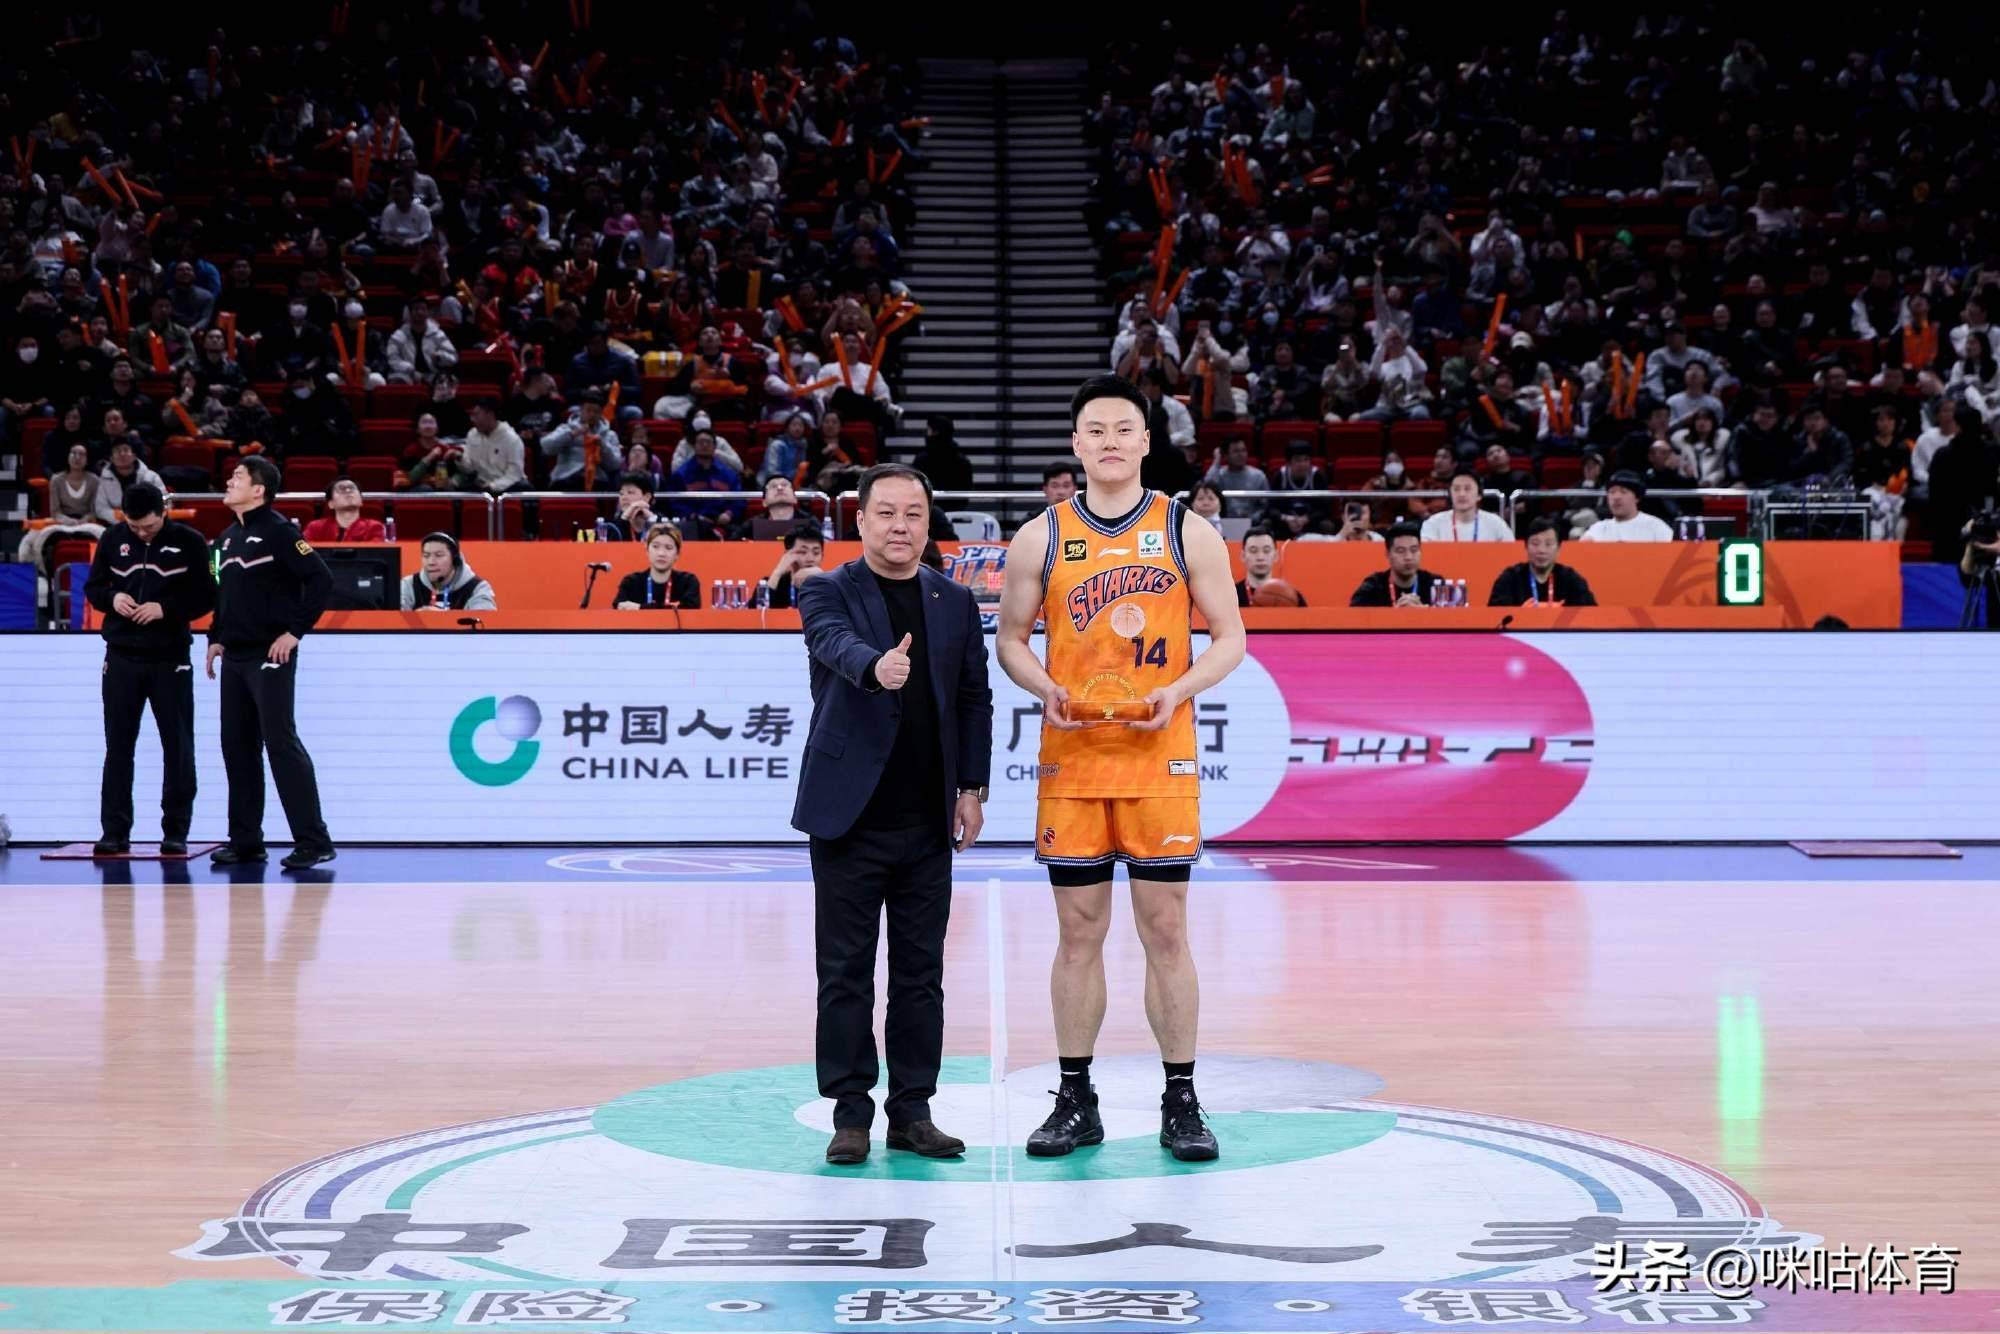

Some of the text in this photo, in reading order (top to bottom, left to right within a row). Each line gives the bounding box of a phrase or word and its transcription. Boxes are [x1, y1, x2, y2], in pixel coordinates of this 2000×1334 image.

[1725, 544, 1760, 603] 0
[1068, 566, 1177, 632] SHARKS
[1132, 636, 1167, 669] 14
[1106, 673, 1119, 682] THE
[563, 702, 794, 748] 中国人寿
[562, 757, 788, 779] CHINA LIFE
